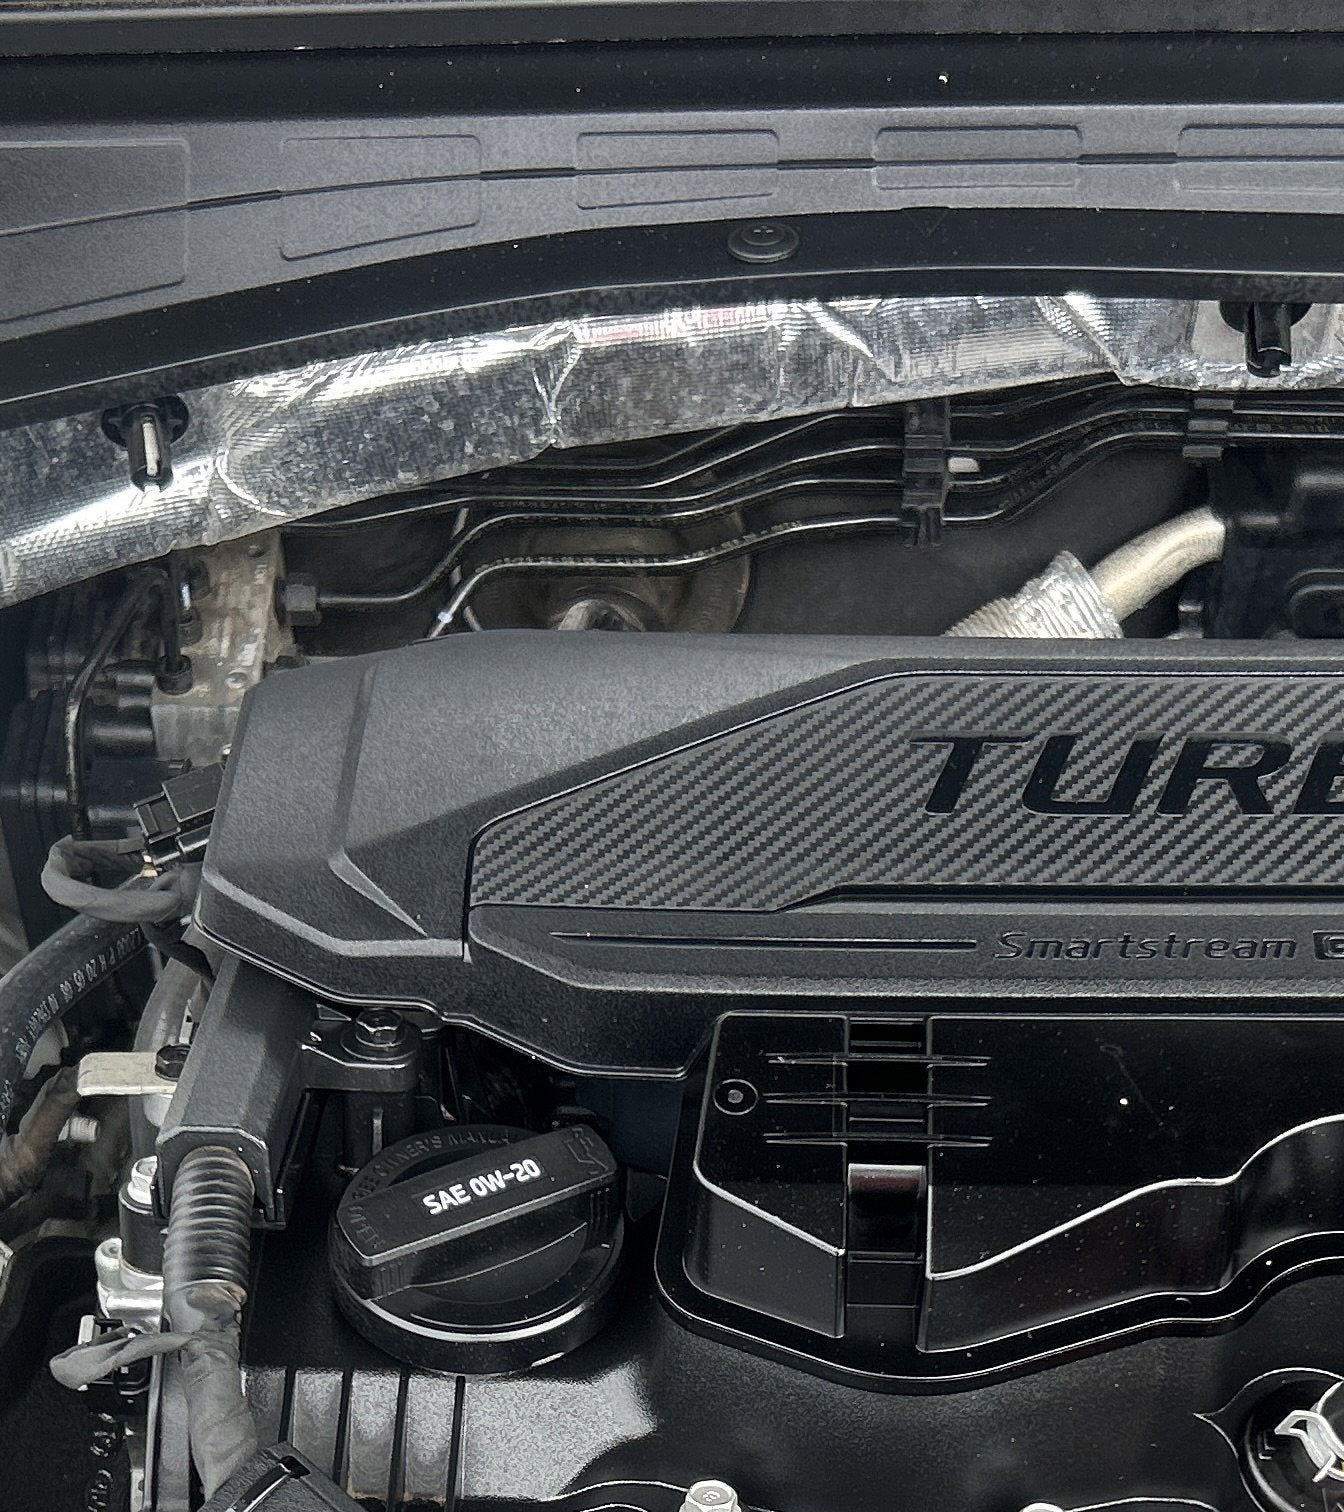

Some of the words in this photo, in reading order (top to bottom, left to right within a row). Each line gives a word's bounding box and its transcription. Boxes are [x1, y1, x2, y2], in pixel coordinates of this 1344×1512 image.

[995, 932, 1296, 961] Smartstream
[422, 1183, 472, 1215] SAE
[469, 1158, 542, 1198] 0W-20
